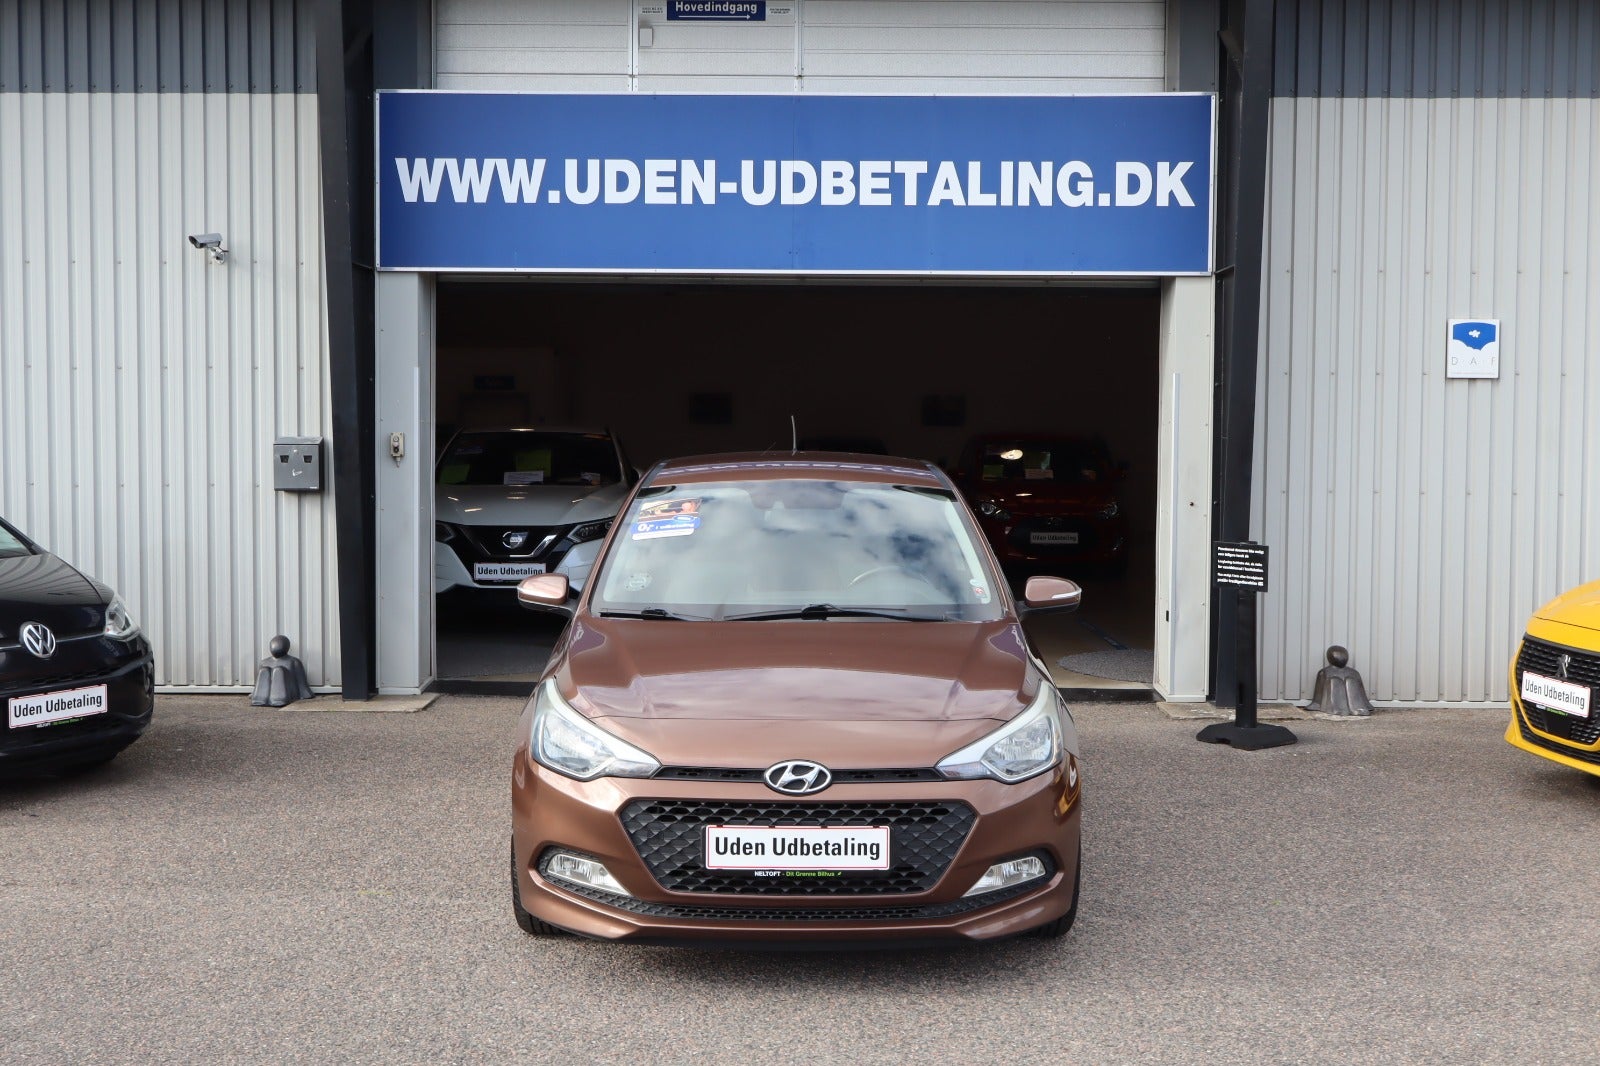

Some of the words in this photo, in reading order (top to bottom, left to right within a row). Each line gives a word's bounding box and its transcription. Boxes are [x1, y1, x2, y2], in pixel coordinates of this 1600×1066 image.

[675, 1, 758, 14] Hovedindgang
[395, 157, 1196, 208] WWW.UDEN-UDBETALING.DK
[477, 567, 498, 575] Uden
[14, 703, 42, 718] Uden
[45, 694, 102, 713] Udbetaling
[1525, 678, 1542, 695] Uden
[1543, 684, 1585, 710] Udbetaling
[715, 836, 766, 856] Uden
[772, 837, 880, 861] Udbetaling
